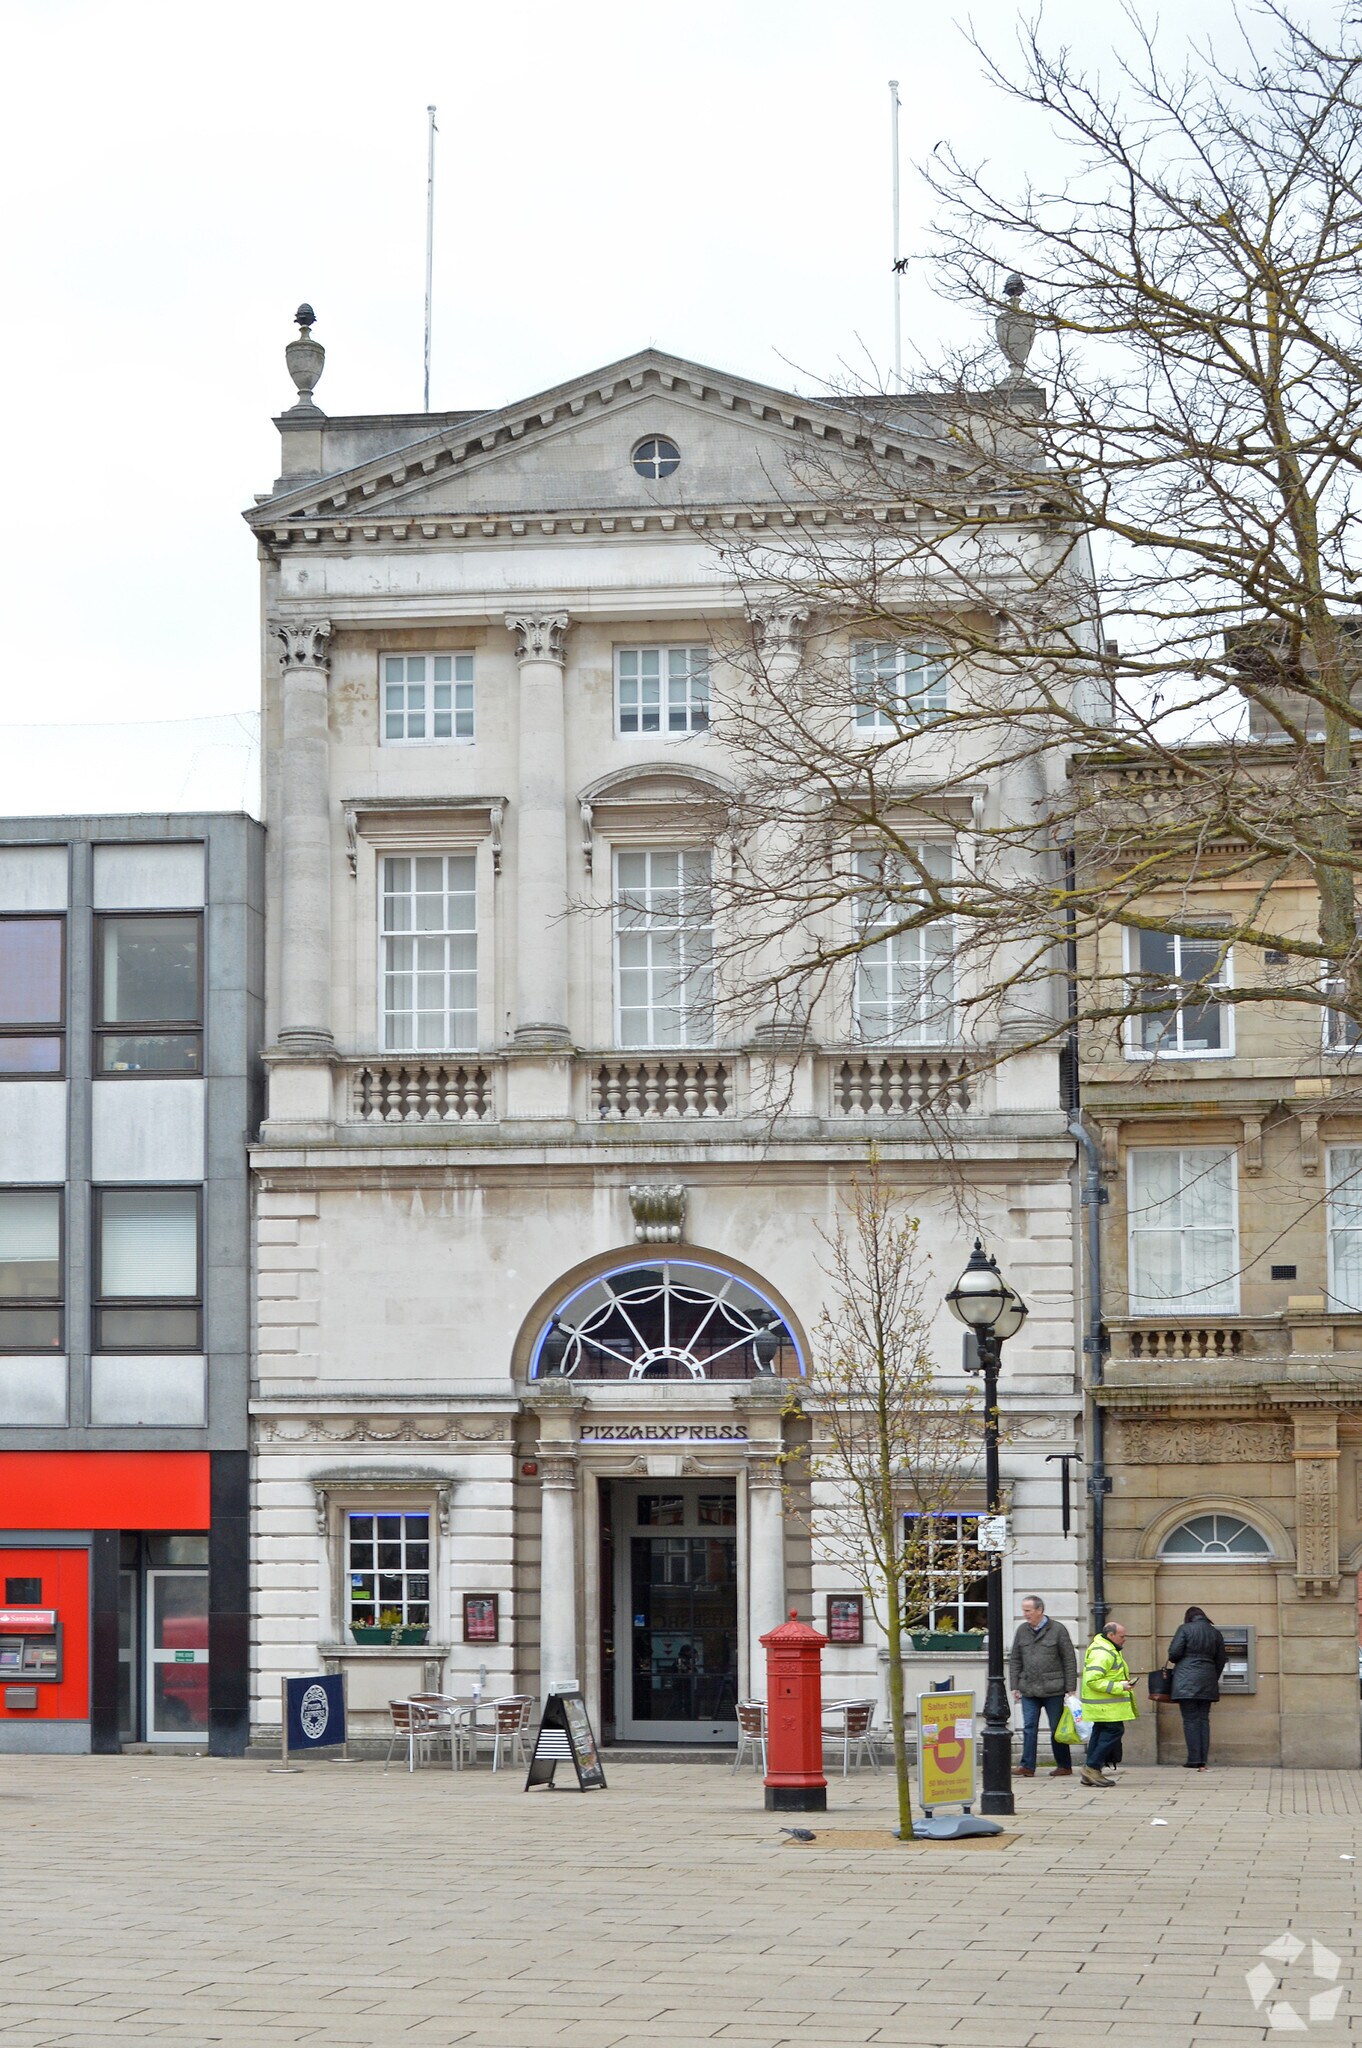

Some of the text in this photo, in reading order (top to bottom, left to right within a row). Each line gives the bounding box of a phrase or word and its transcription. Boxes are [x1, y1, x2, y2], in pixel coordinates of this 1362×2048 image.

[579, 1425, 748, 1440] PIZZAEXPRESS
[10, 1614, 44, 1622] Santander
[948, 1701, 968, 1709] Street
[924, 1715, 940, 1724] Toys
[943, 1714, 948, 1722] &
